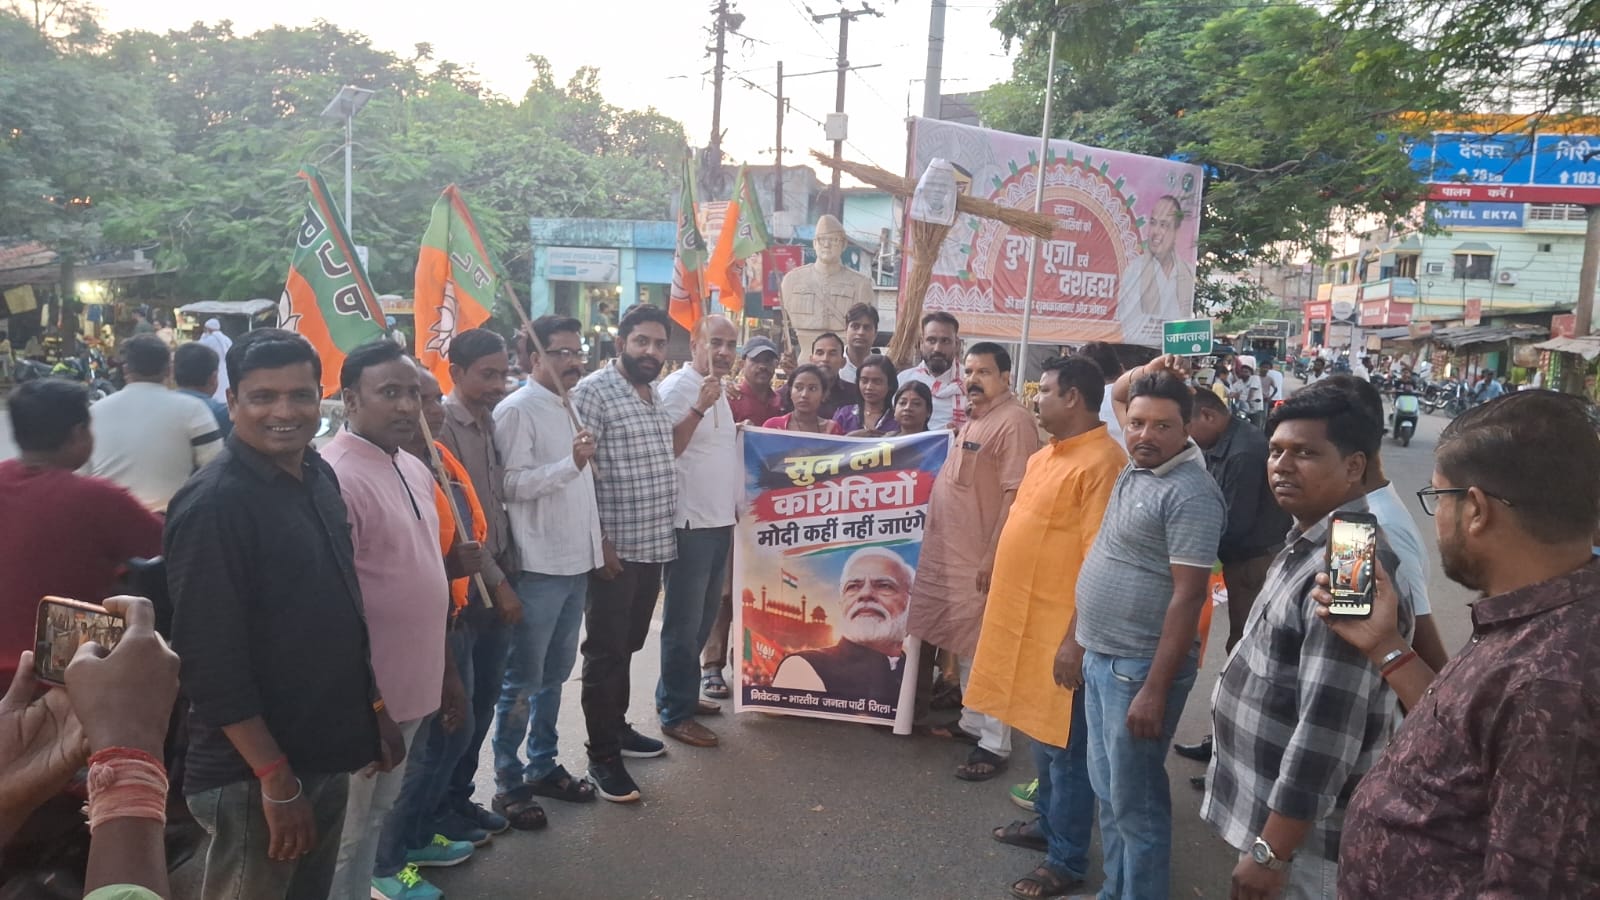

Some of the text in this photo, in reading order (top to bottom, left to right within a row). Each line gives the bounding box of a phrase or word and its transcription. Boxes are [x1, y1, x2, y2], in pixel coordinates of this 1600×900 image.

[1442, 187, 1471, 198] पालन
[1572, 171, 1596, 185] 103
[1482, 210, 1517, 220] EKTA
[1042, 240, 1077, 274] पूजा
[1059, 269, 1117, 298] दशहरा
[784, 442, 895, 486] सुन लो
[771, 471, 918, 516] कांग्रेसियों
[758, 509, 927, 547] मोदी कहीं नहीं जाएंगे
[750, 689, 780, 702] निवेदक
[788, 693, 819, 706] भारतीय
[822, 699, 848, 709] जनता
[849, 698, 865, 711] पार्टी
[868, 700, 891, 714] जिला
